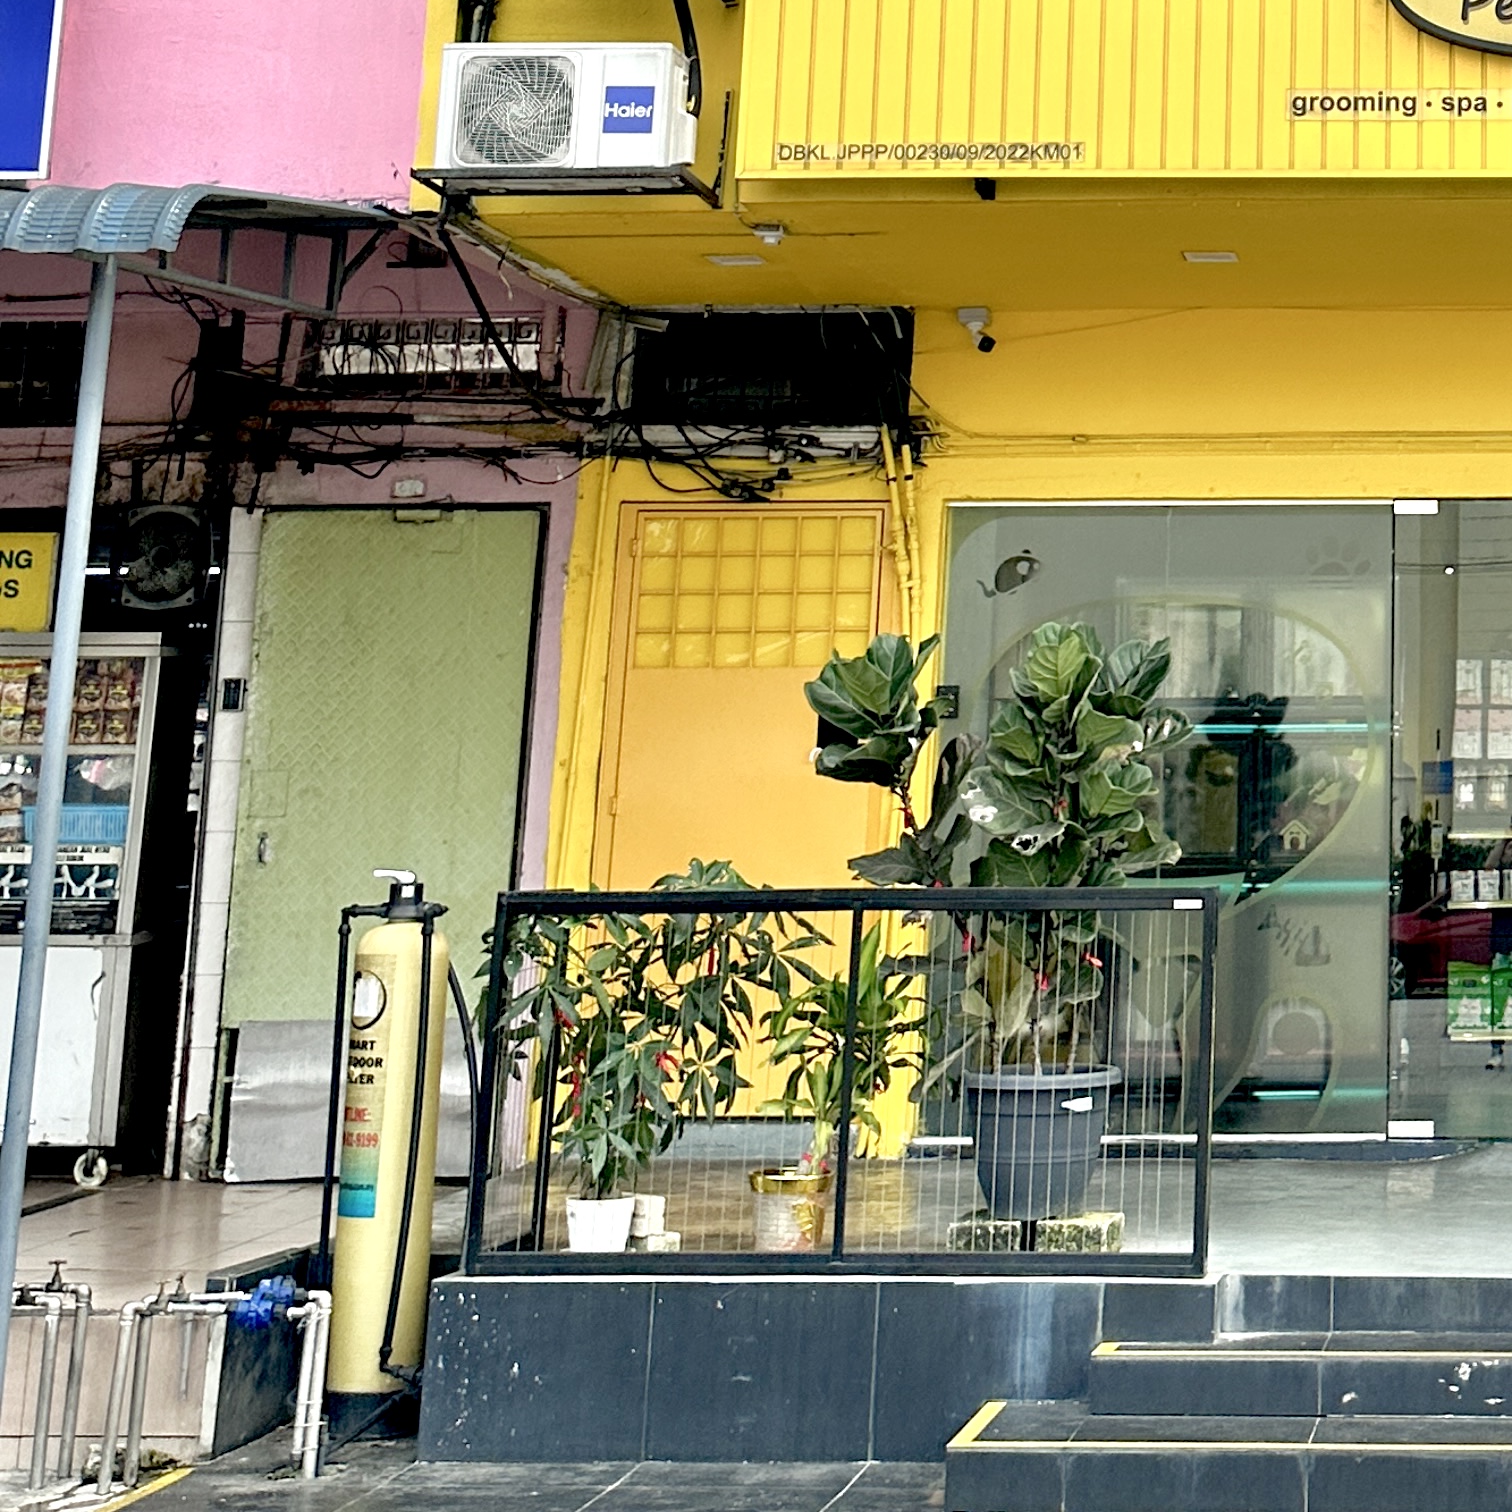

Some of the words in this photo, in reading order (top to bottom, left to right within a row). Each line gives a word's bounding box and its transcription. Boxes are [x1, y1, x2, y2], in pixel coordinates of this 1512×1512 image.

[604, 100, 653, 119] Haier
[1292, 91, 1417, 116] grooming
[1441, 96, 1487, 117] spa
